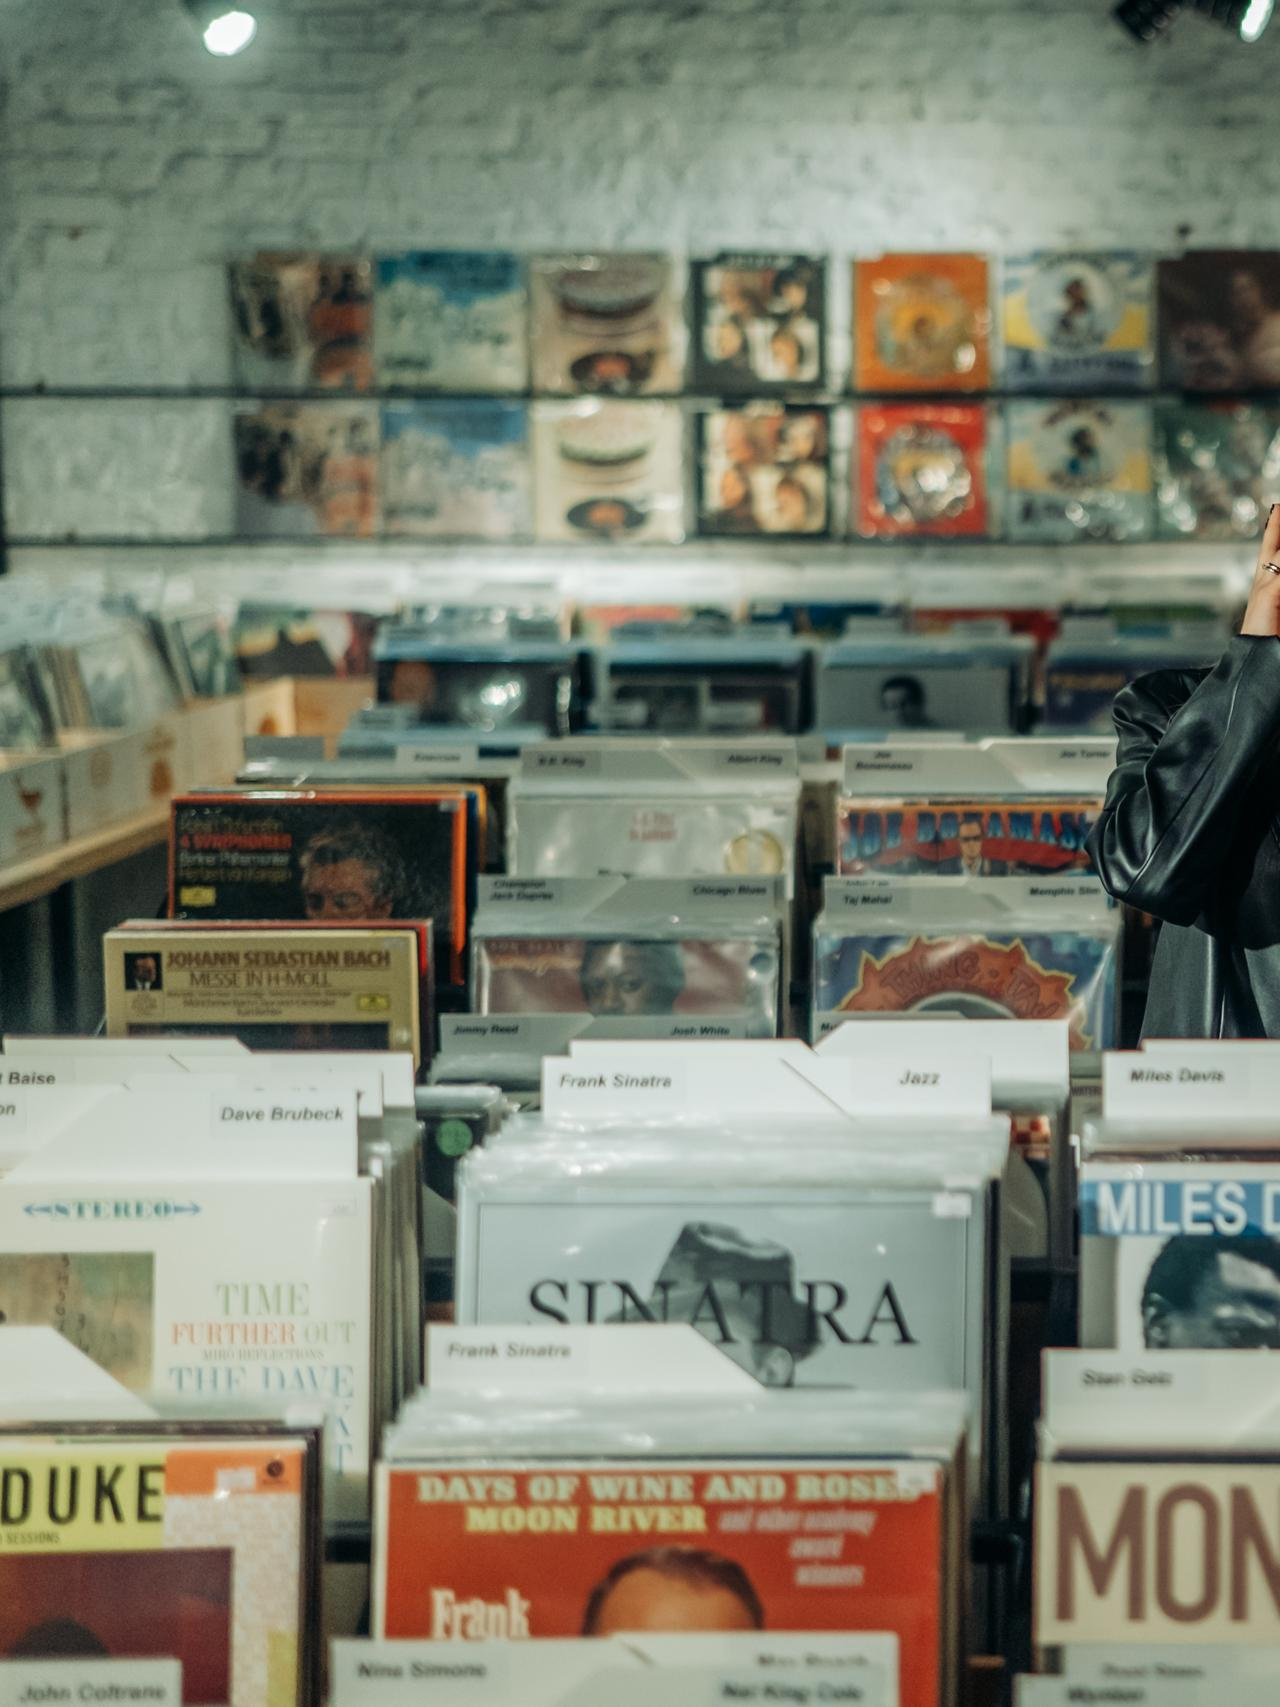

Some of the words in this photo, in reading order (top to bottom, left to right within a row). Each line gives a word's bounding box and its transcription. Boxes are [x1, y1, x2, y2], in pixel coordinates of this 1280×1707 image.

[167, 951, 240, 967] JOHANN
[244, 951, 338, 967] SEBASTIAN
[343, 951, 390, 967] BACH
[190, 971, 238, 987] MESSE
[247, 971, 262, 986] IN
[8, 1071, 56, 1085] Baise
[559, 1073, 607, 1088] Frank
[612, 1073, 672, 1088] Sinatra
[900, 1070, 941, 1086] Jazz
[1130, 1068, 1173, 1083] Miles
[1176, 1068, 1225, 1083] Davis
[220, 1107, 265, 1121] Dave
[271, 1107, 345, 1122] Brubeck
[50, 1200, 175, 1218] STEREO
[1098, 1180, 1248, 1235] MILES
[216, 1282, 310, 1317] TIME
[528, 1278, 920, 1346] SINATRA
[171, 1322, 297, 1346] FURTHER
[303, 1320, 357, 1345] OUT
[447, 1342, 499, 1359] Frank
[506, 1342, 572, 1359] Sinatra
[169, 1366, 247, 1392] THE
[260, 1364, 355, 1398] DAVE
[2, 1463, 166, 1525] DUKE
[417, 1475, 518, 1502] DAYS
[528, 1475, 580, 1502] OF
[587, 1475, 696, 1502] WINE
[703, 1475, 789, 1502] AND
[466, 1506, 579, 1534] MOON
[589, 1506, 708, 1534] RIVER
[430, 1588, 531, 1639] Frank
[19, 1683, 72, 1703] John
[78, 1683, 166, 1702] Coltrane
